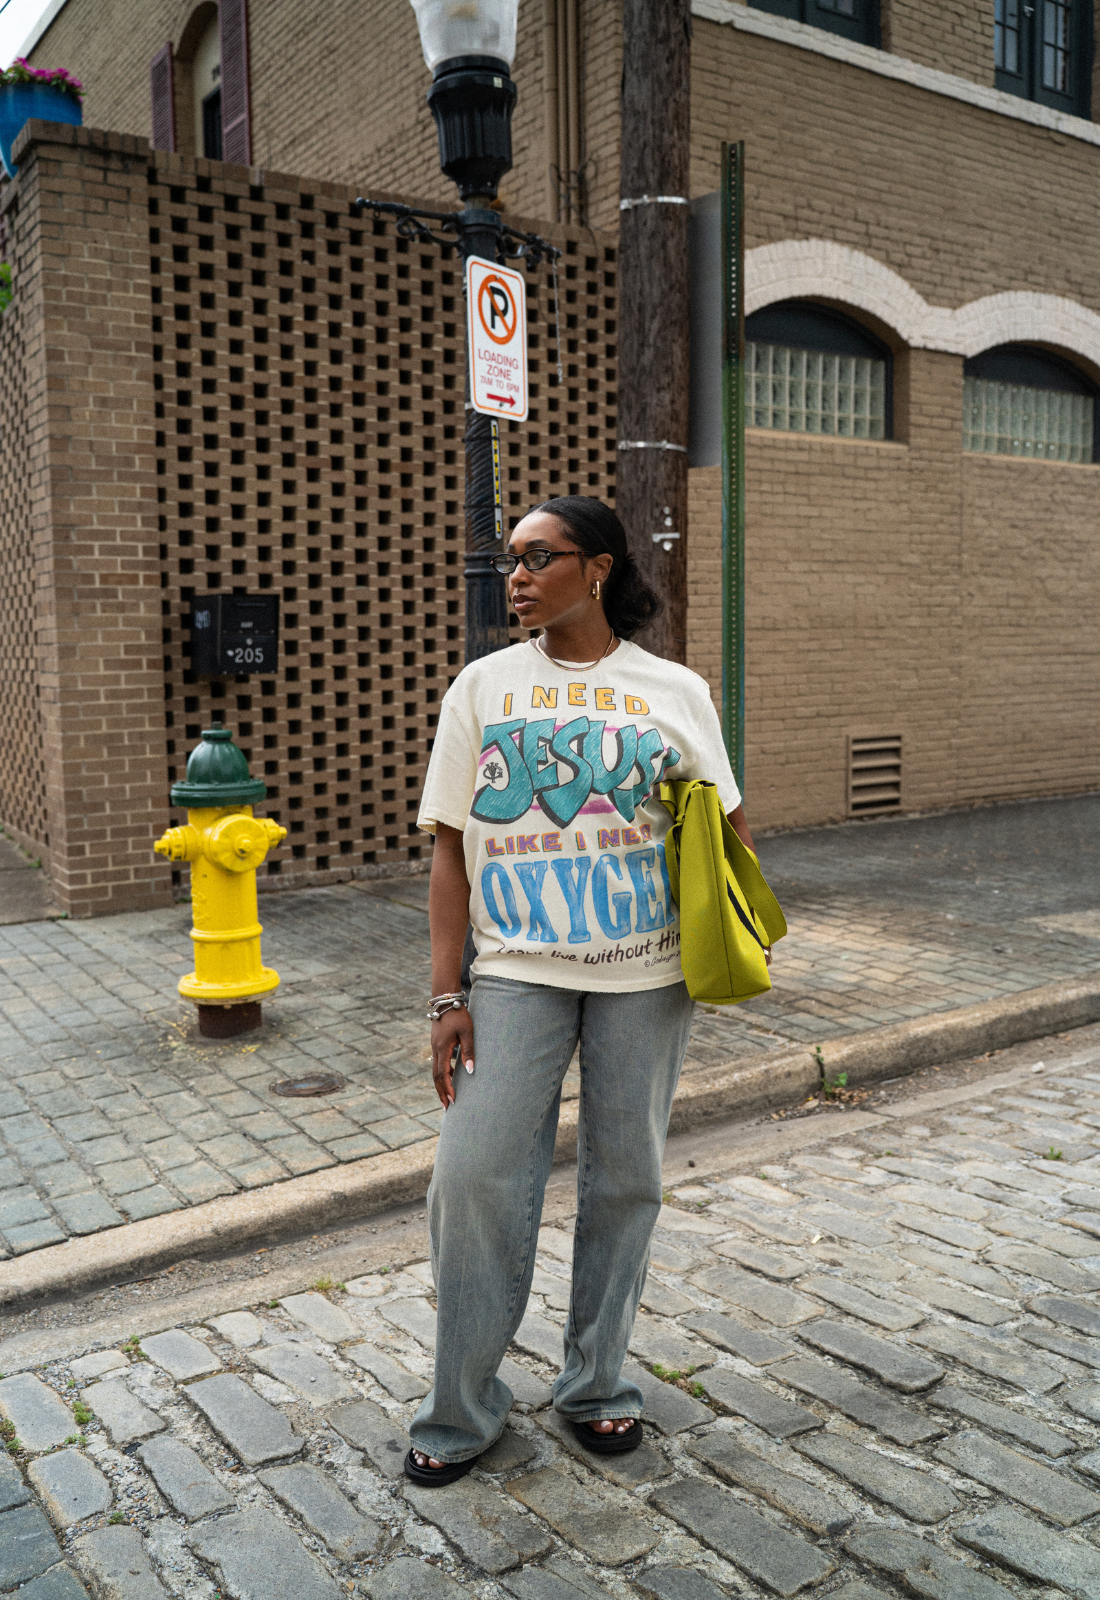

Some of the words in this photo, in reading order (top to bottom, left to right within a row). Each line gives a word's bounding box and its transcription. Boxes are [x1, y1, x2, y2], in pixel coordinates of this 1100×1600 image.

[478, 348, 519, 370] LOADING
[480, 375, 493, 386] 7AM
[495, 379, 504, 389] TO
[486, 364, 512, 381] ZONE
[234, 647, 264, 663] 205
[503, 693, 513, 716] I
[531, 682, 650, 716] NEED
[469, 715, 682, 829] JESUS
[485, 831, 563, 857] LIKE
[575, 831, 587, 851] I
[551, 950, 578, 961] live
[583, 938, 654, 965] without
